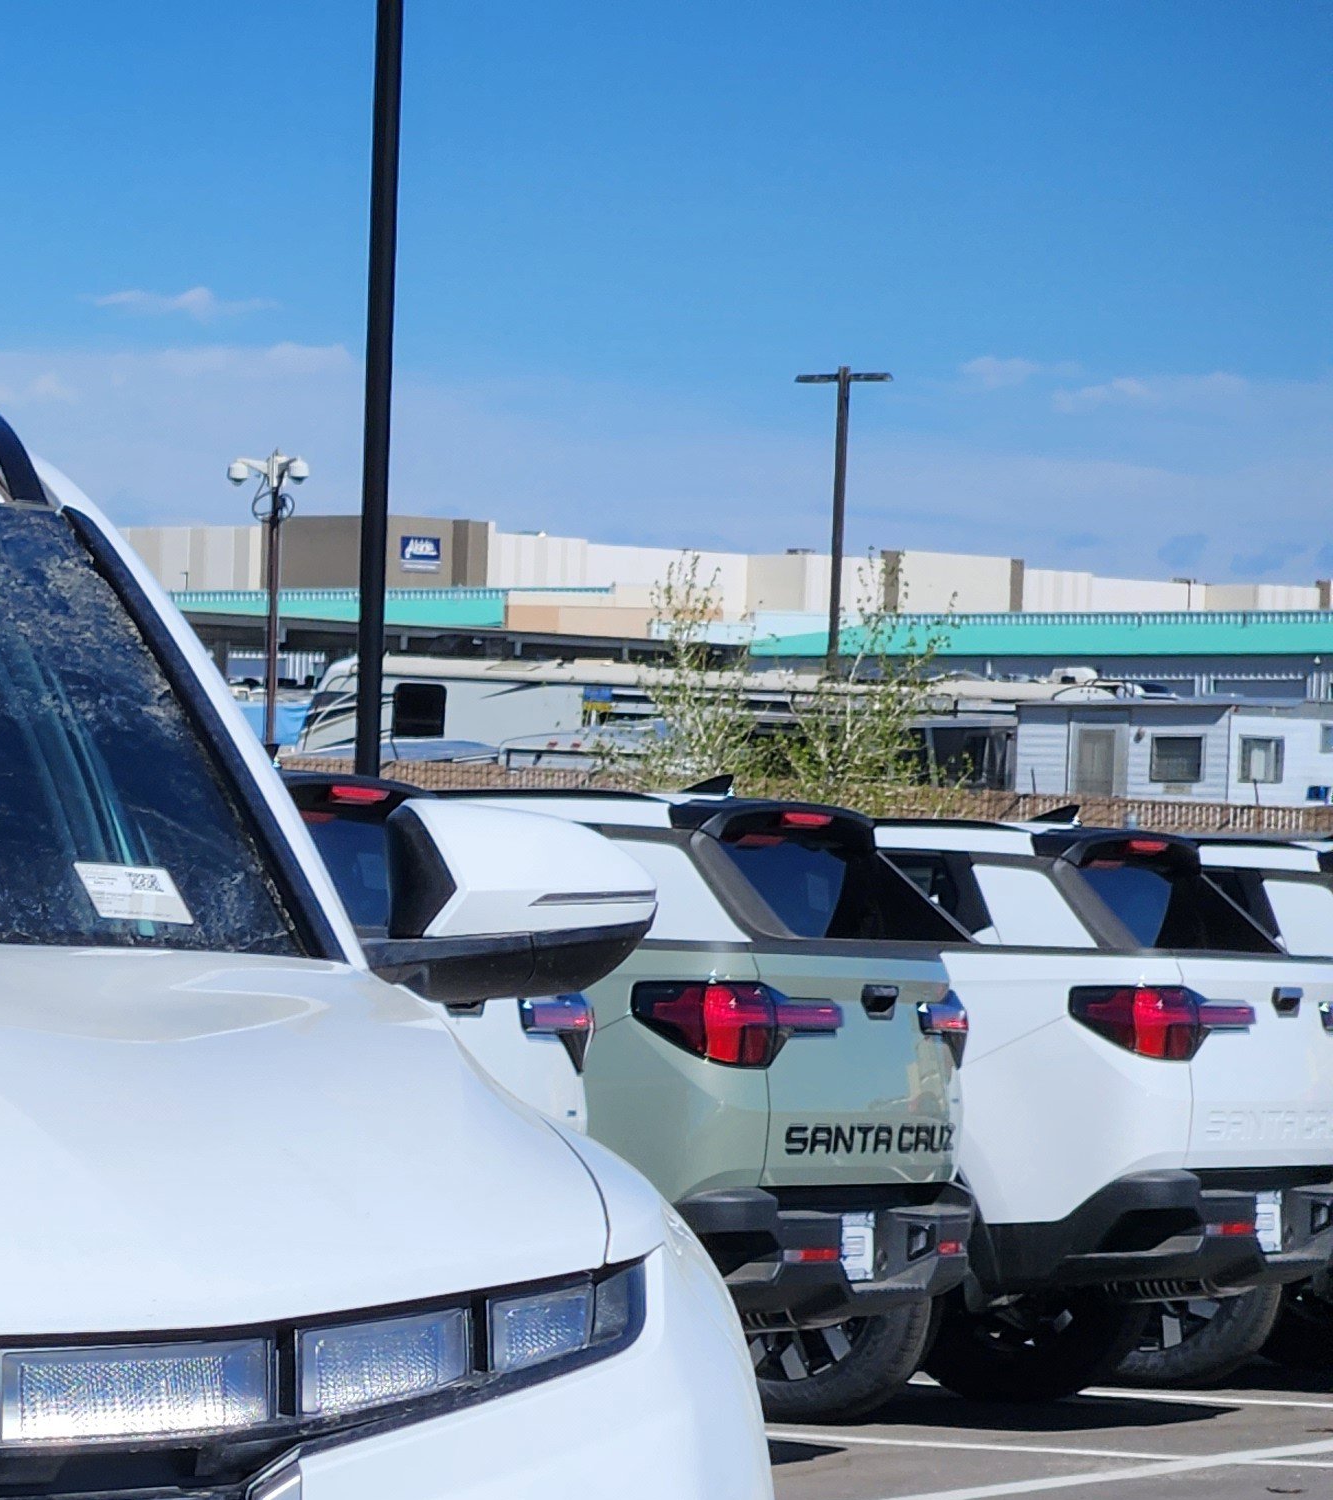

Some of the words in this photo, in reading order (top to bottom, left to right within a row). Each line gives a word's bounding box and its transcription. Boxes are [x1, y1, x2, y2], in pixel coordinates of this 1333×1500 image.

[785, 1123, 892, 1156] SANTA
[897, 1122, 955, 1155] CRUZ
[1206, 1110, 1297, 1140] SANTA
